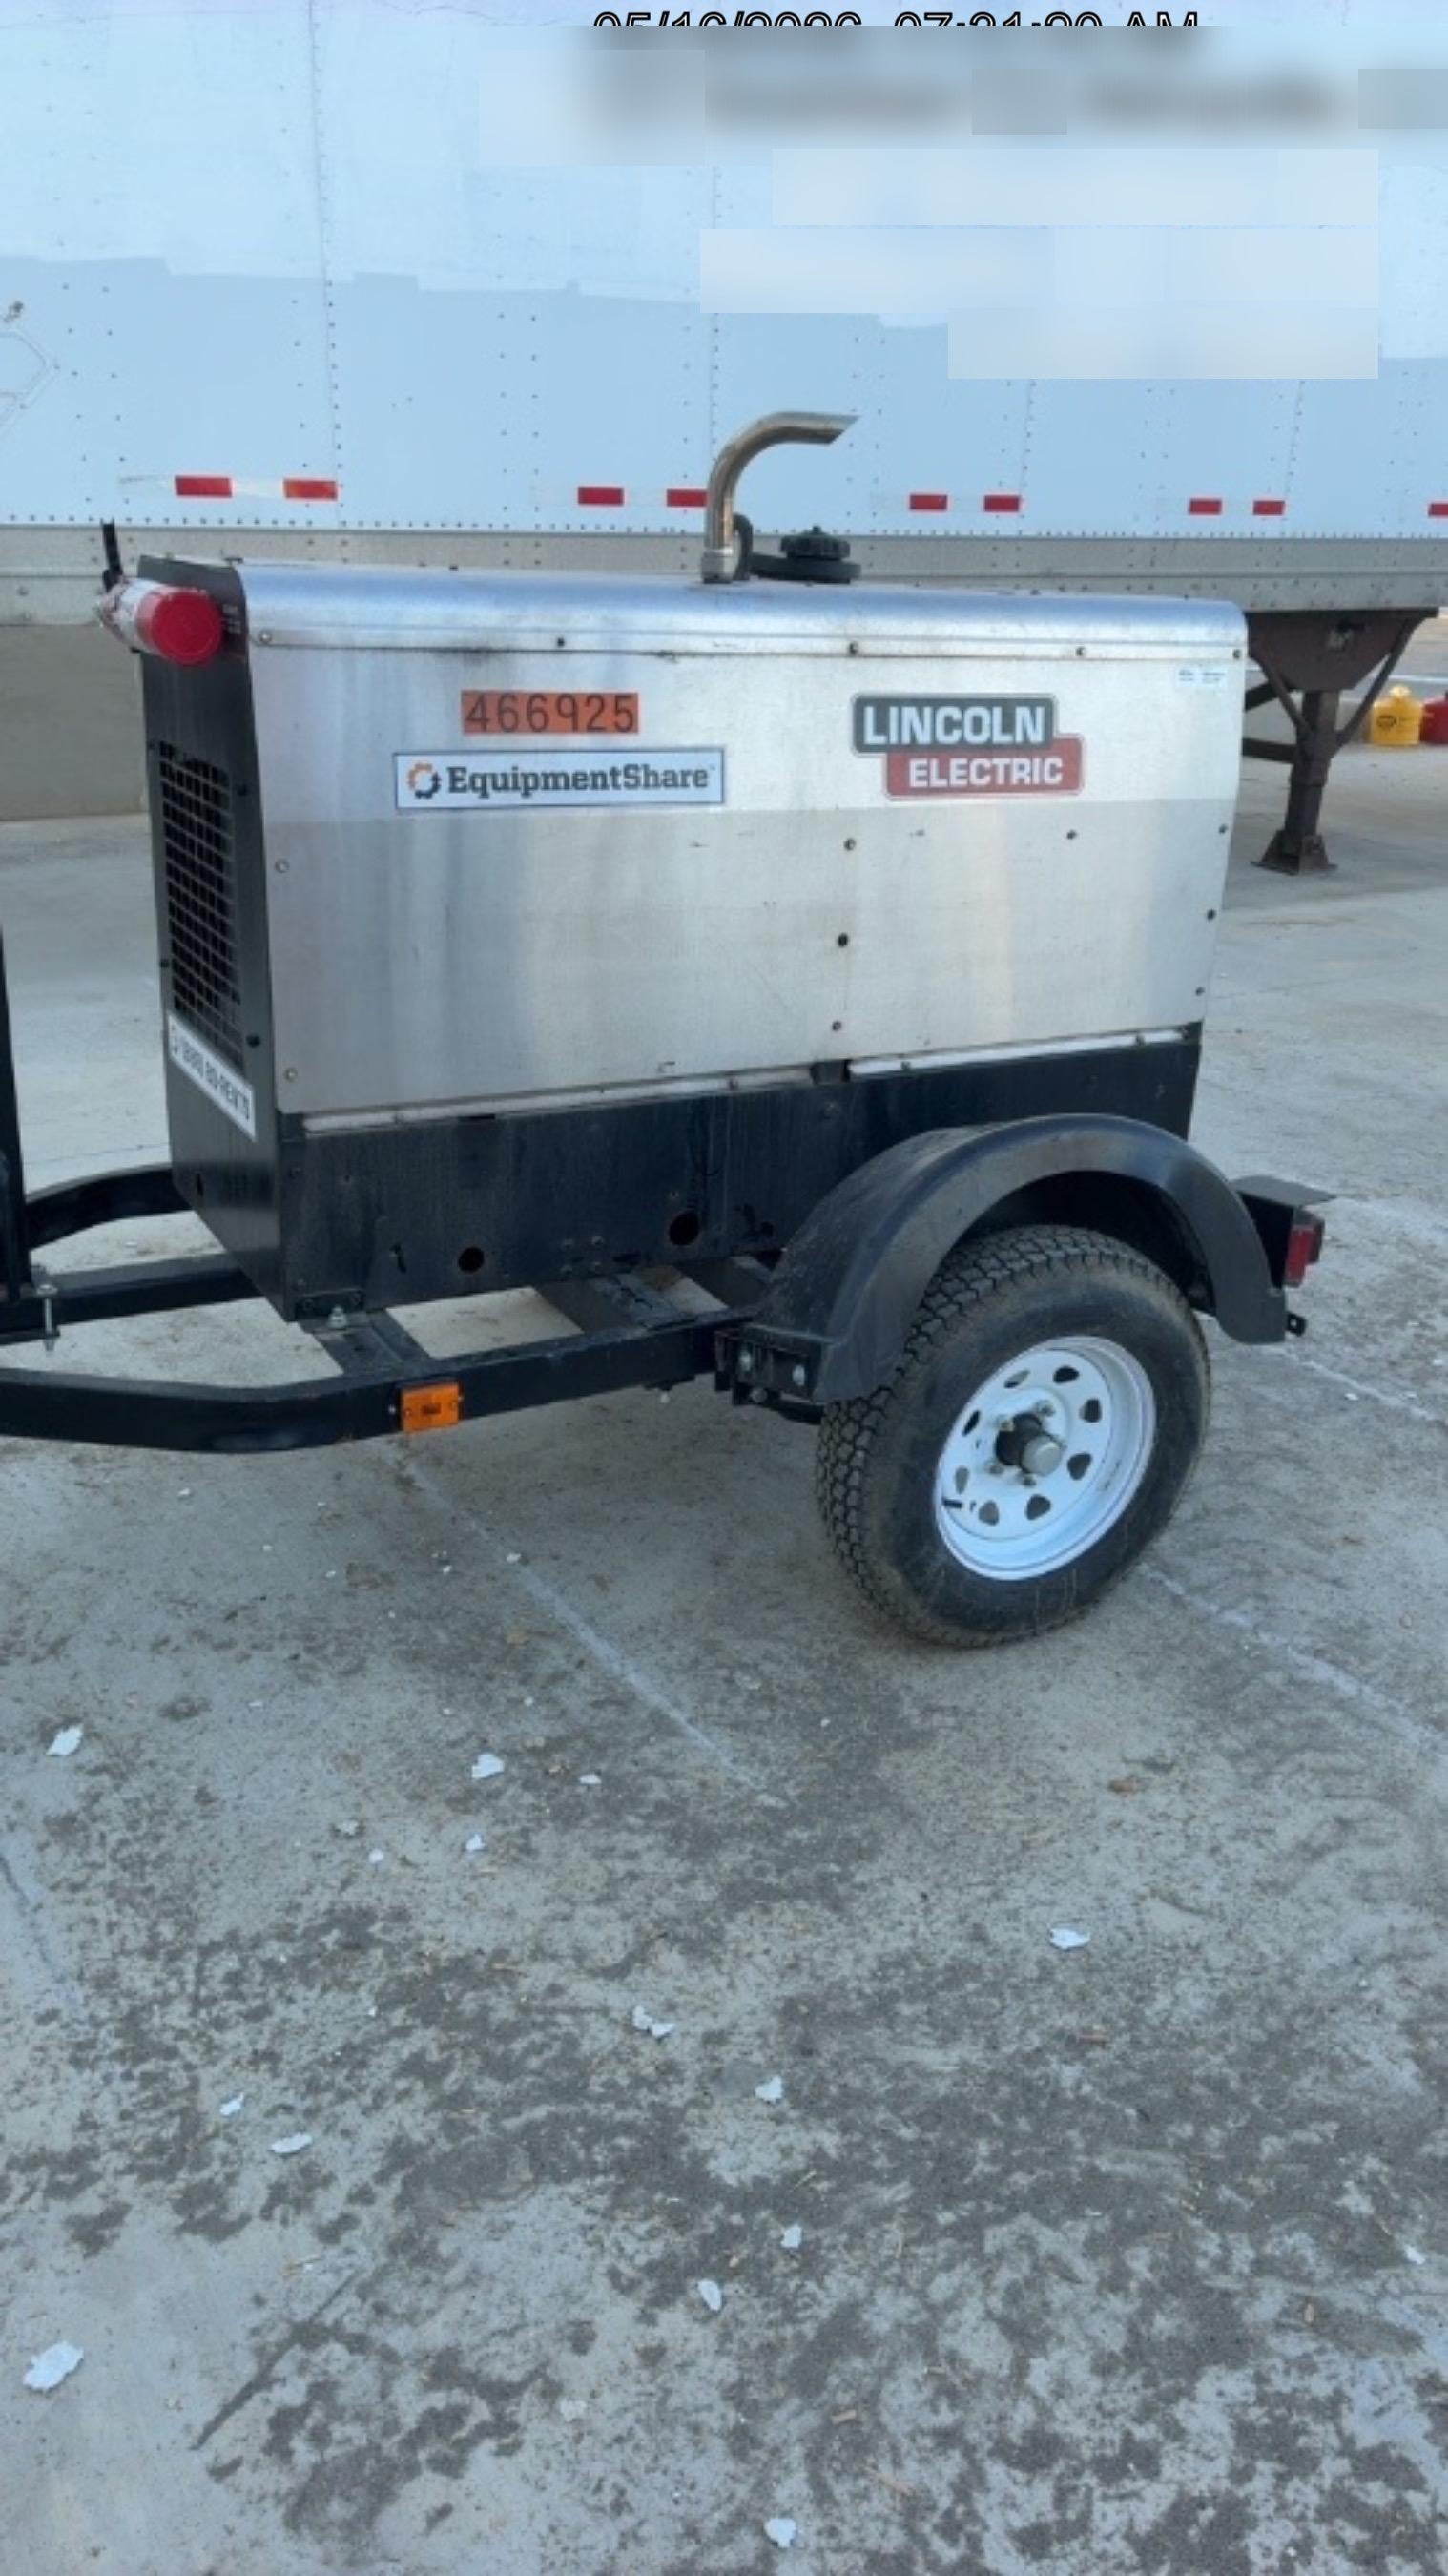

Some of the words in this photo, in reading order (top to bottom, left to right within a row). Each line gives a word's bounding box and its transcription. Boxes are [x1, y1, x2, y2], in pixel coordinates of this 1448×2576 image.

[465, 692, 634, 734] 466925
[863, 705, 1045, 746] LINCOLN
[446, 763, 708, 799] EquipmentShare
[908, 757, 1064, 789] ELECTRIC
